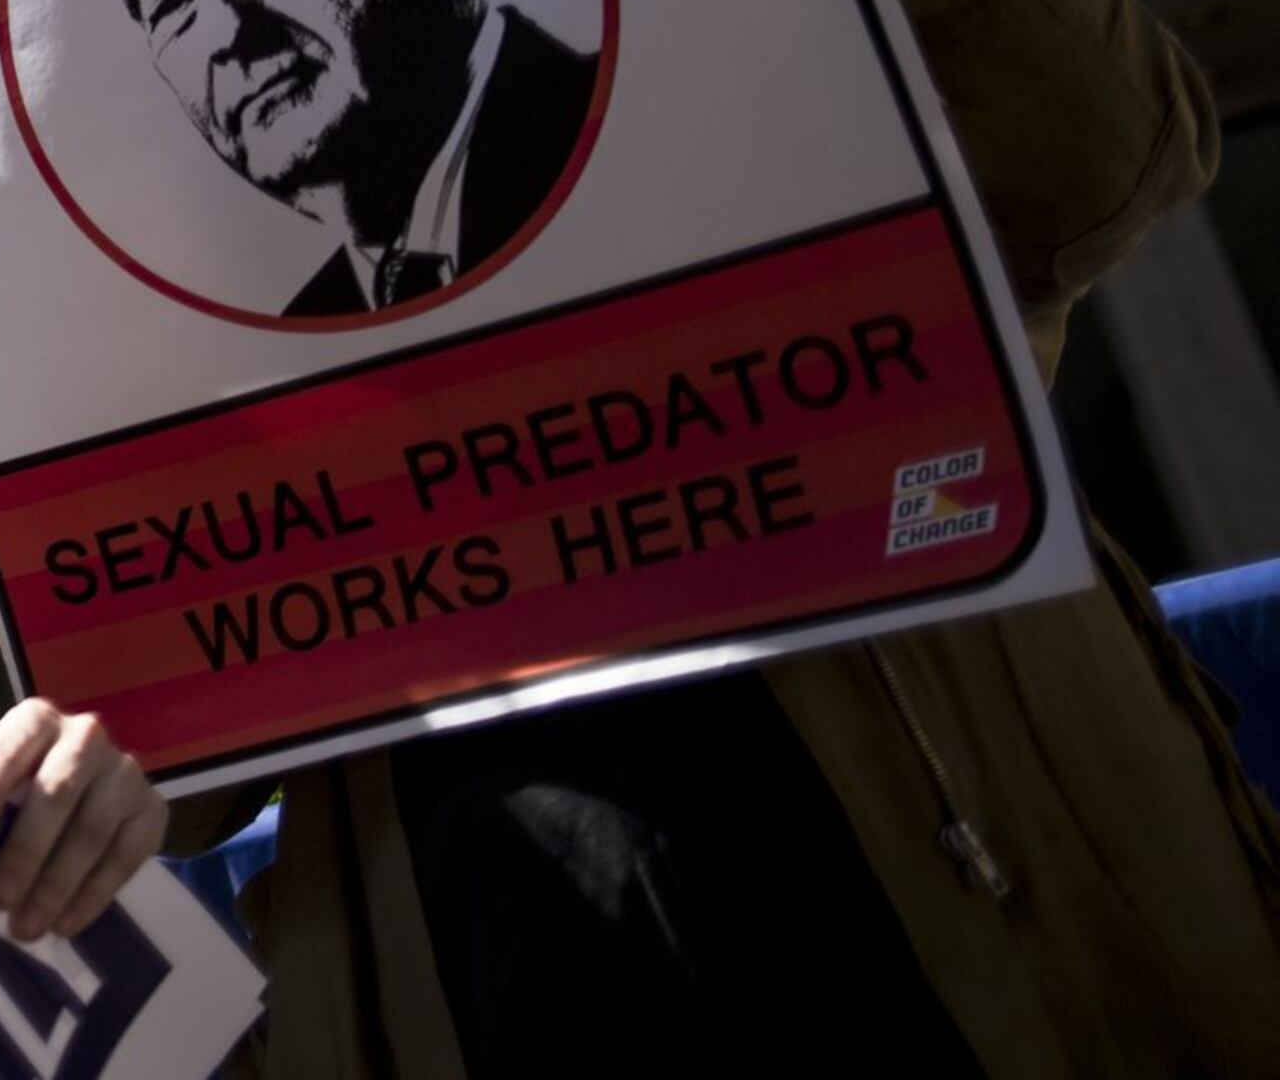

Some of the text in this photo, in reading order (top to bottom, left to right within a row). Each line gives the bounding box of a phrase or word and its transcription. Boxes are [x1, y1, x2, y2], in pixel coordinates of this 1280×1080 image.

[44, 314, 931, 605] SEXUAL PREDATOR
[900, 453, 979, 488] COLOR
[897, 495, 929, 518] OF
[893, 509, 990, 548] CHANGE
[183, 455, 817, 672] WORKS HERE
